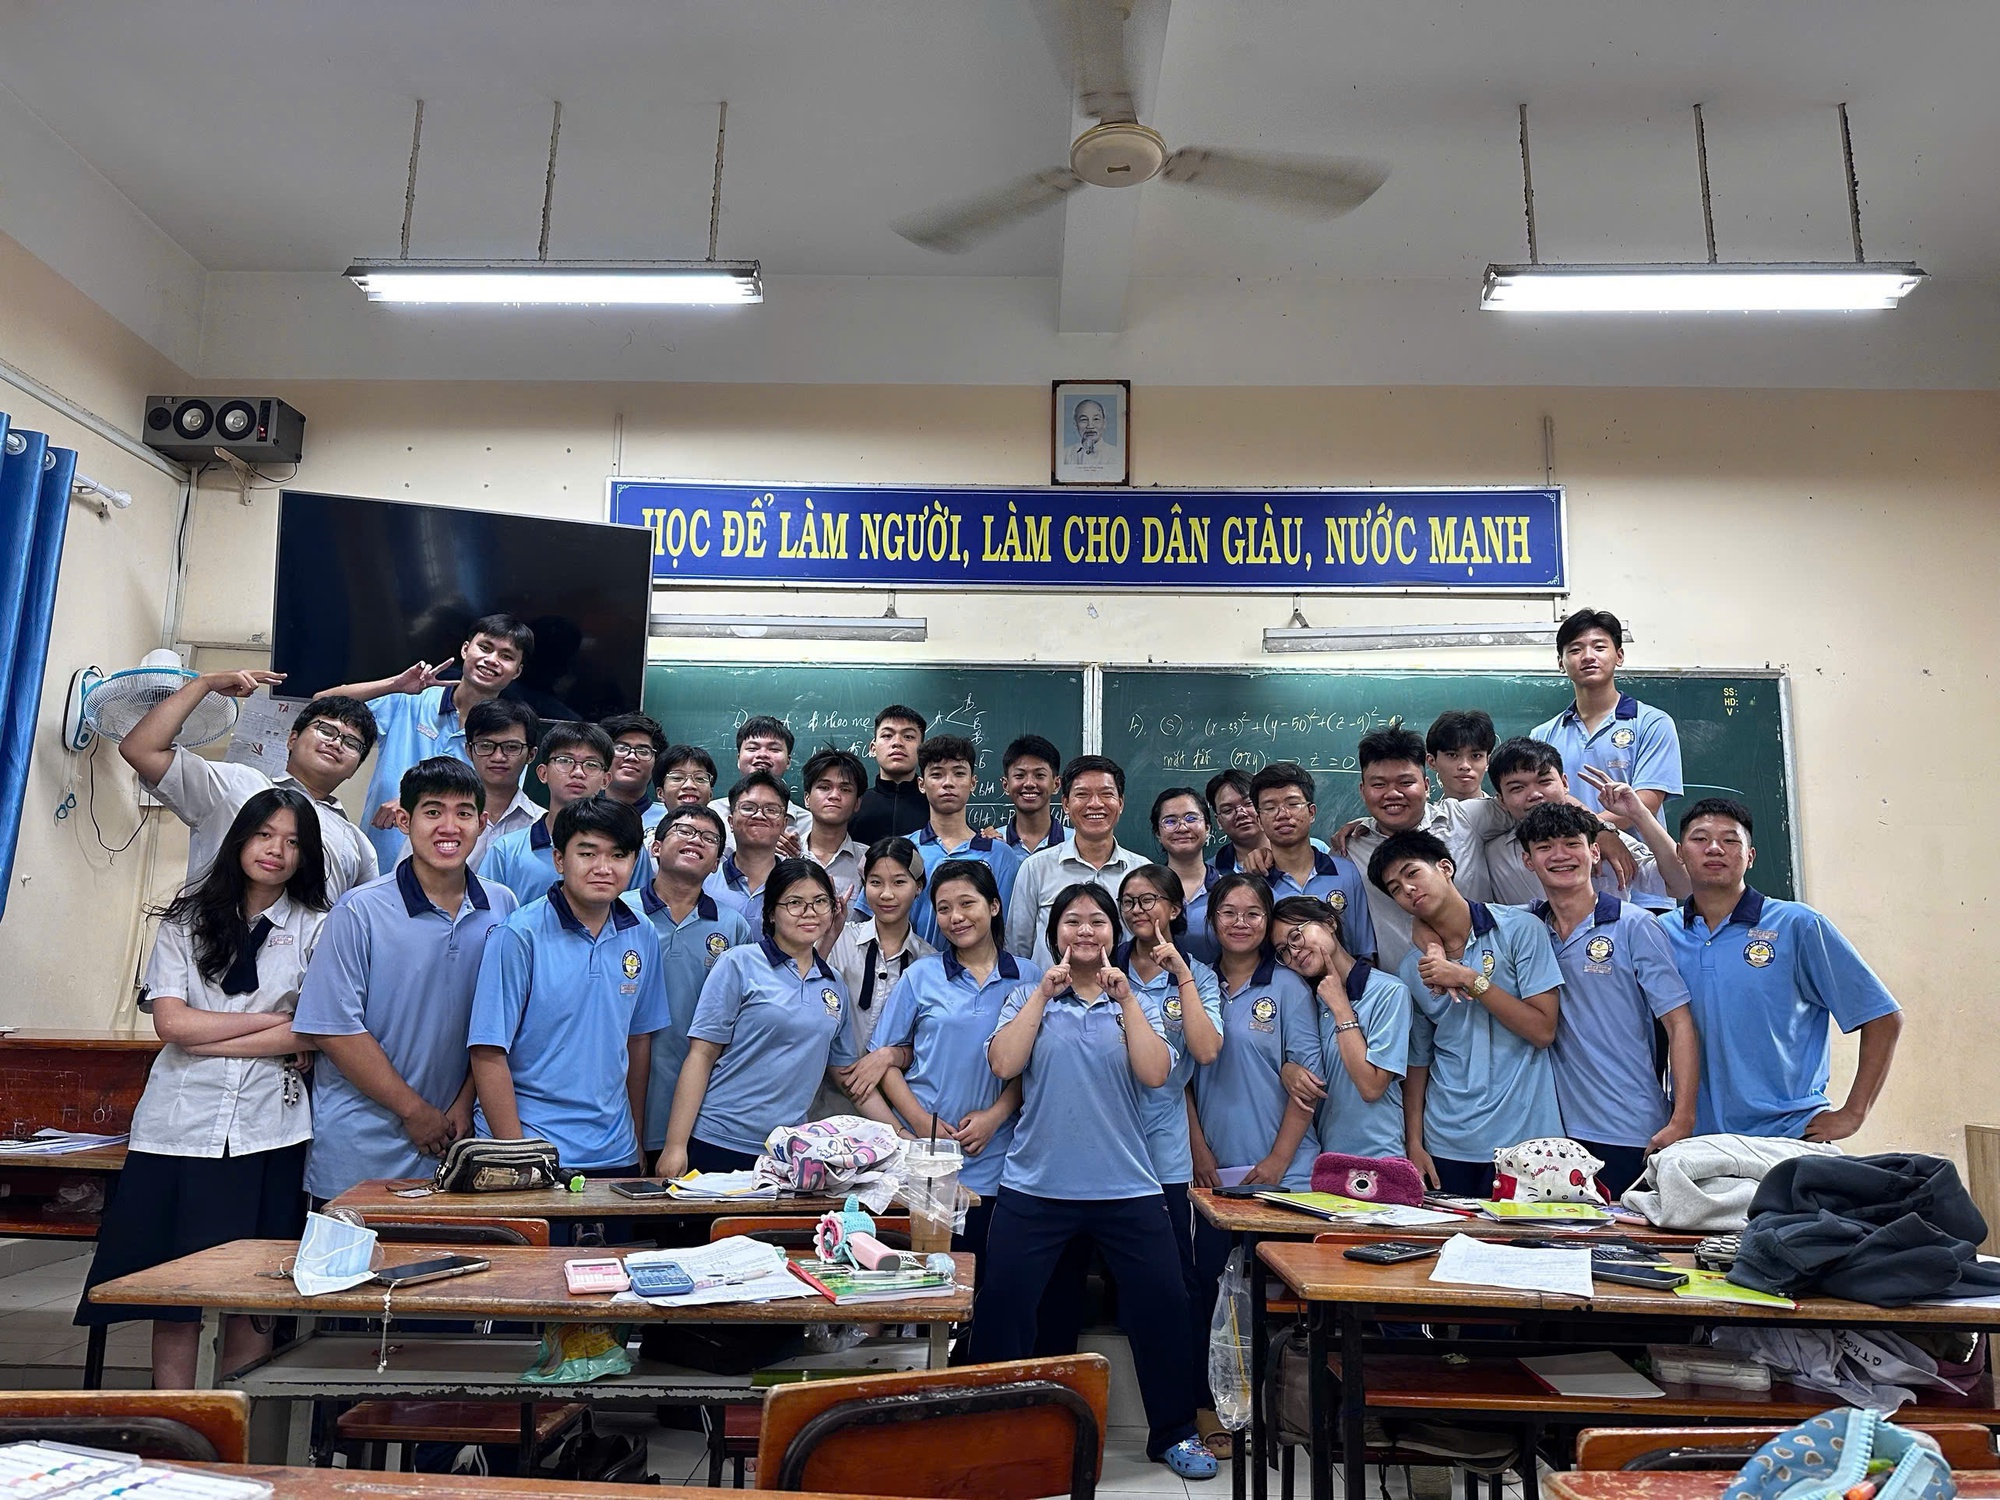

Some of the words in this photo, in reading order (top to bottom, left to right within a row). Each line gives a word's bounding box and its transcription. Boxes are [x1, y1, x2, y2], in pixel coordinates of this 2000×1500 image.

[642, 508, 710, 569] HỌC
[722, 493, 774, 557] ĐỂ
[779, 498, 849, 558] LÀM
[860, 500, 969, 569] NGƯỜI,
[982, 501, 1052, 562] LÀM
[1064, 516, 1130, 563] CHO
[1142, 503, 1210, 563] DÂN
[1222, 503, 1311, 571] GIÀU,
[1325, 503, 1417, 564] NƯỚC
[1428, 516, 1531, 577] MẠNH
[1723, 687, 1738, 696] SS:
[1724, 698, 1739, 706] HD:
